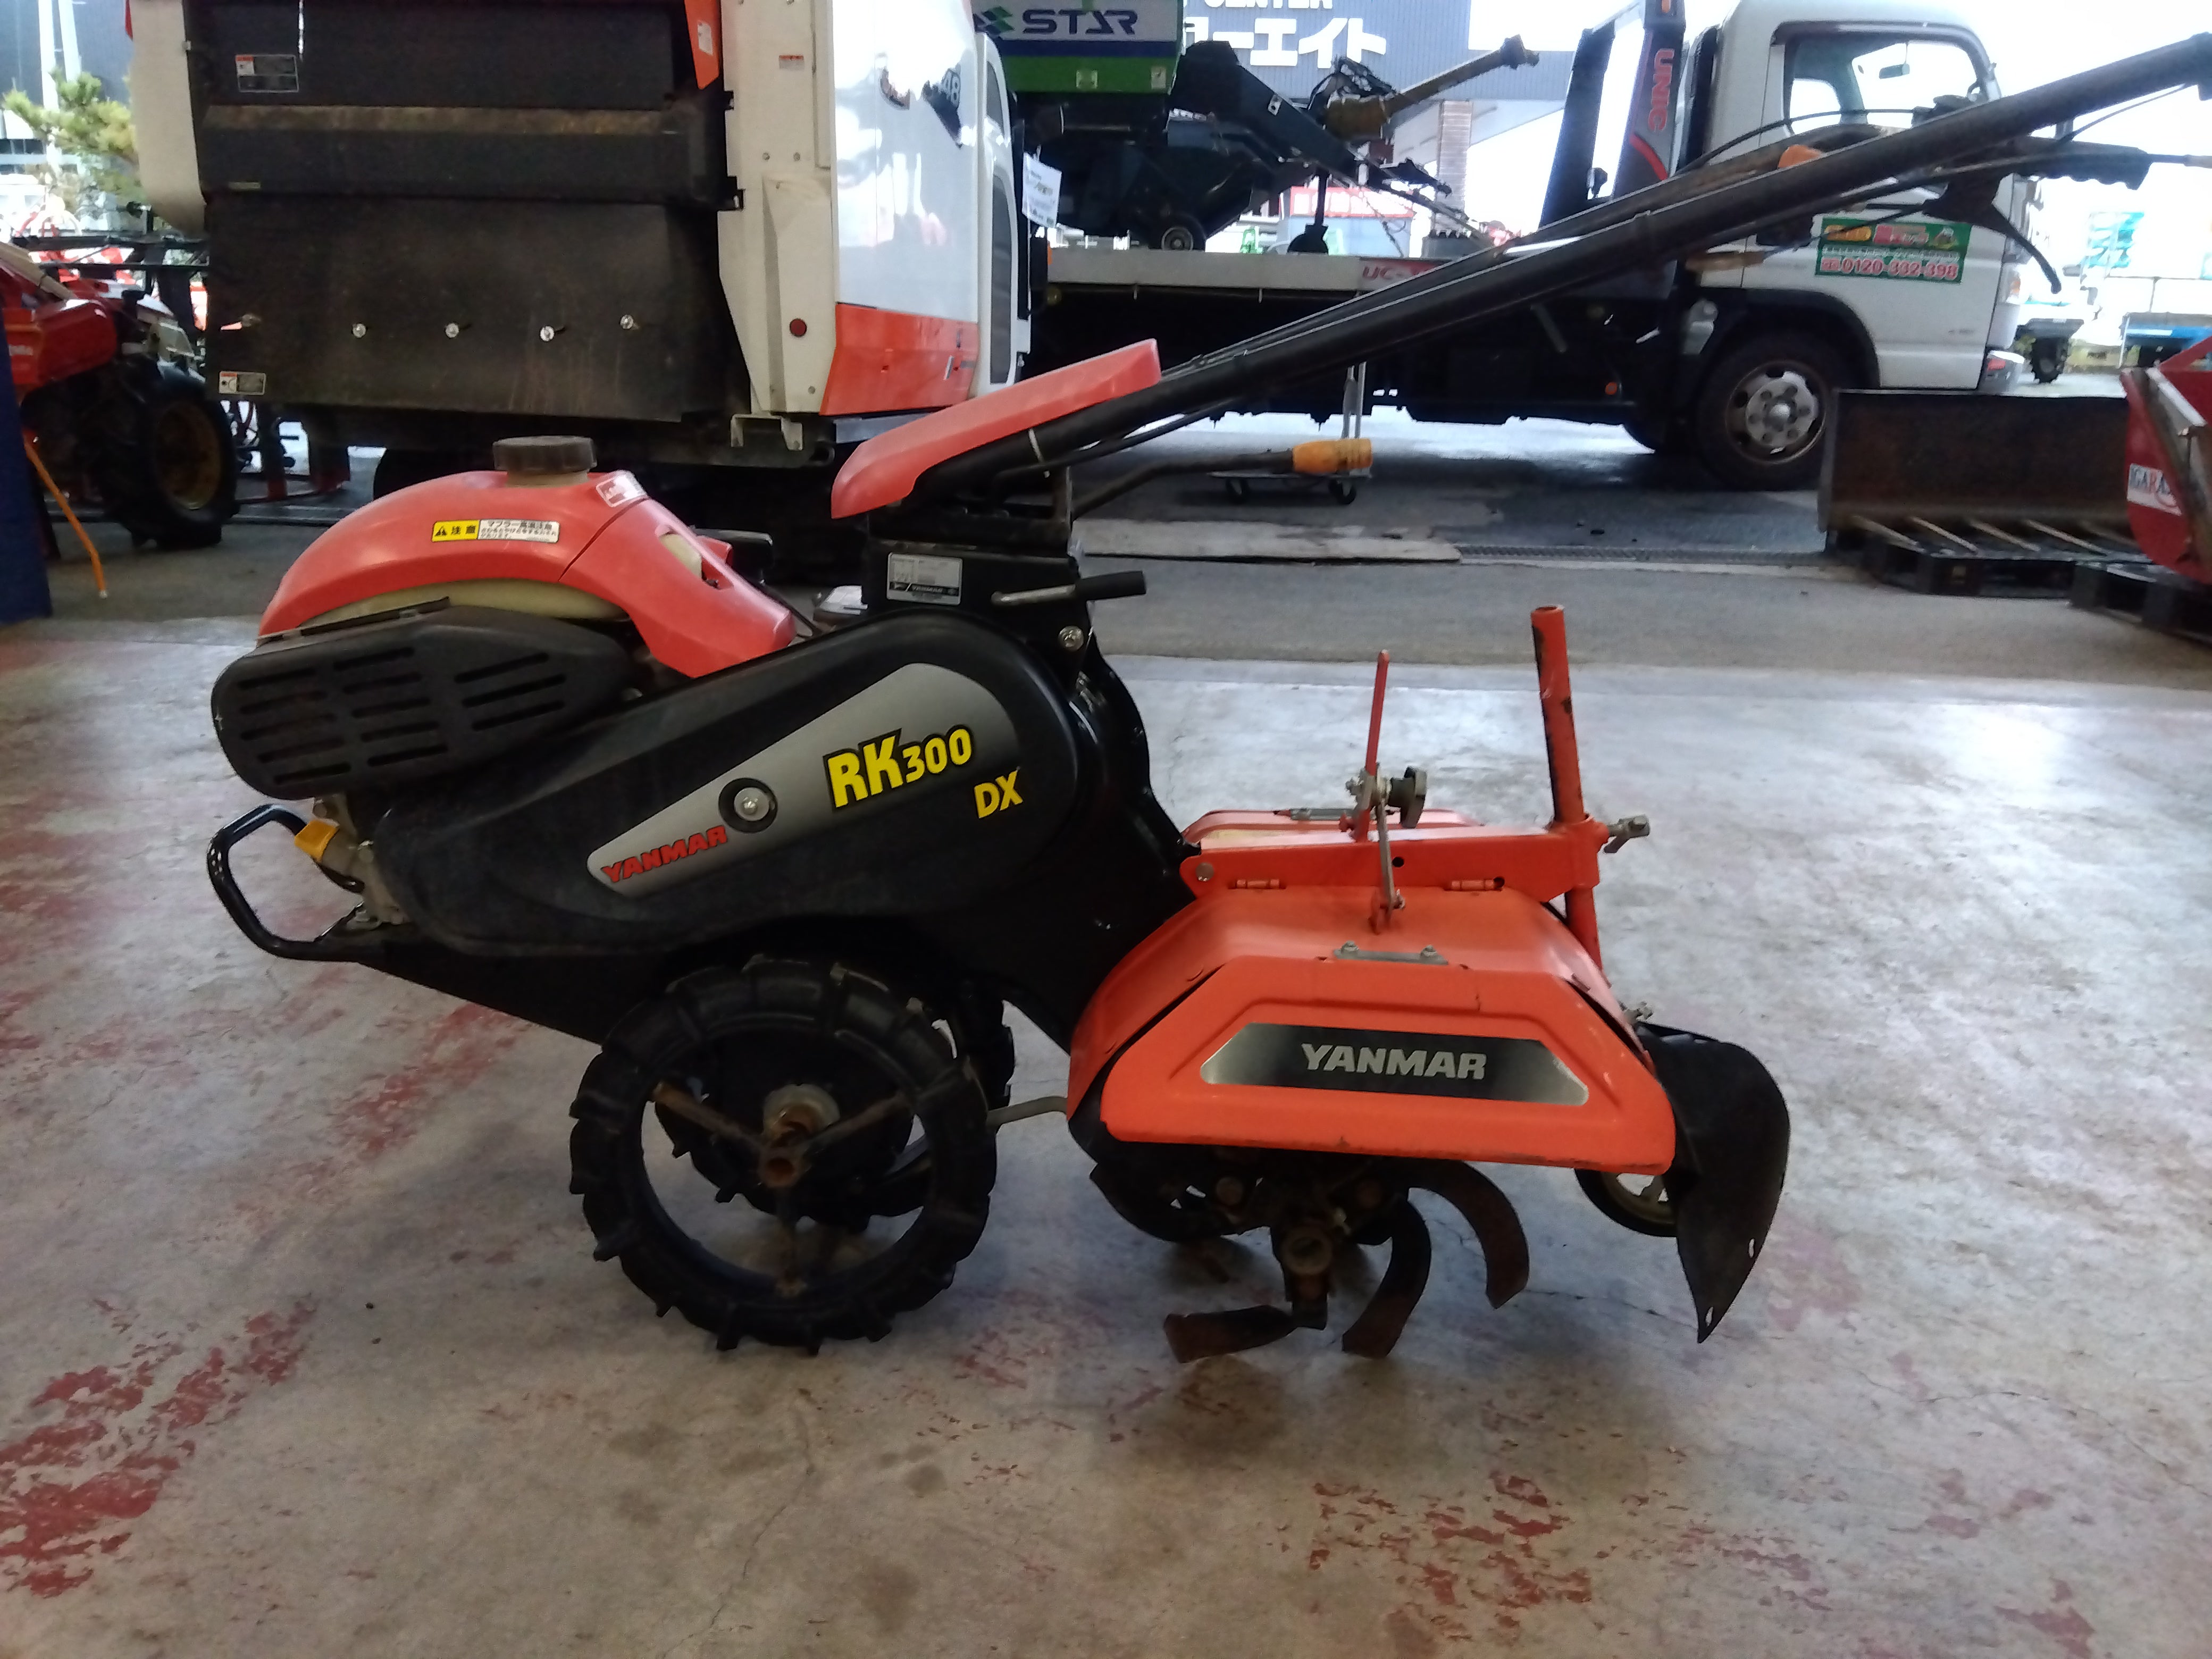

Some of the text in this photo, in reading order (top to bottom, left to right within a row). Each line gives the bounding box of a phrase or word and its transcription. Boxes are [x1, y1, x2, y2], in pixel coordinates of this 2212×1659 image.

[1023, 9, 1138, 35] STAR
[1651, 48, 1674, 131] UNIC
[827, 727, 1023, 819] RK300 DX
[601, 825, 727, 883] YANMAR
[1301, 1043, 1487, 1080] YANMAR
